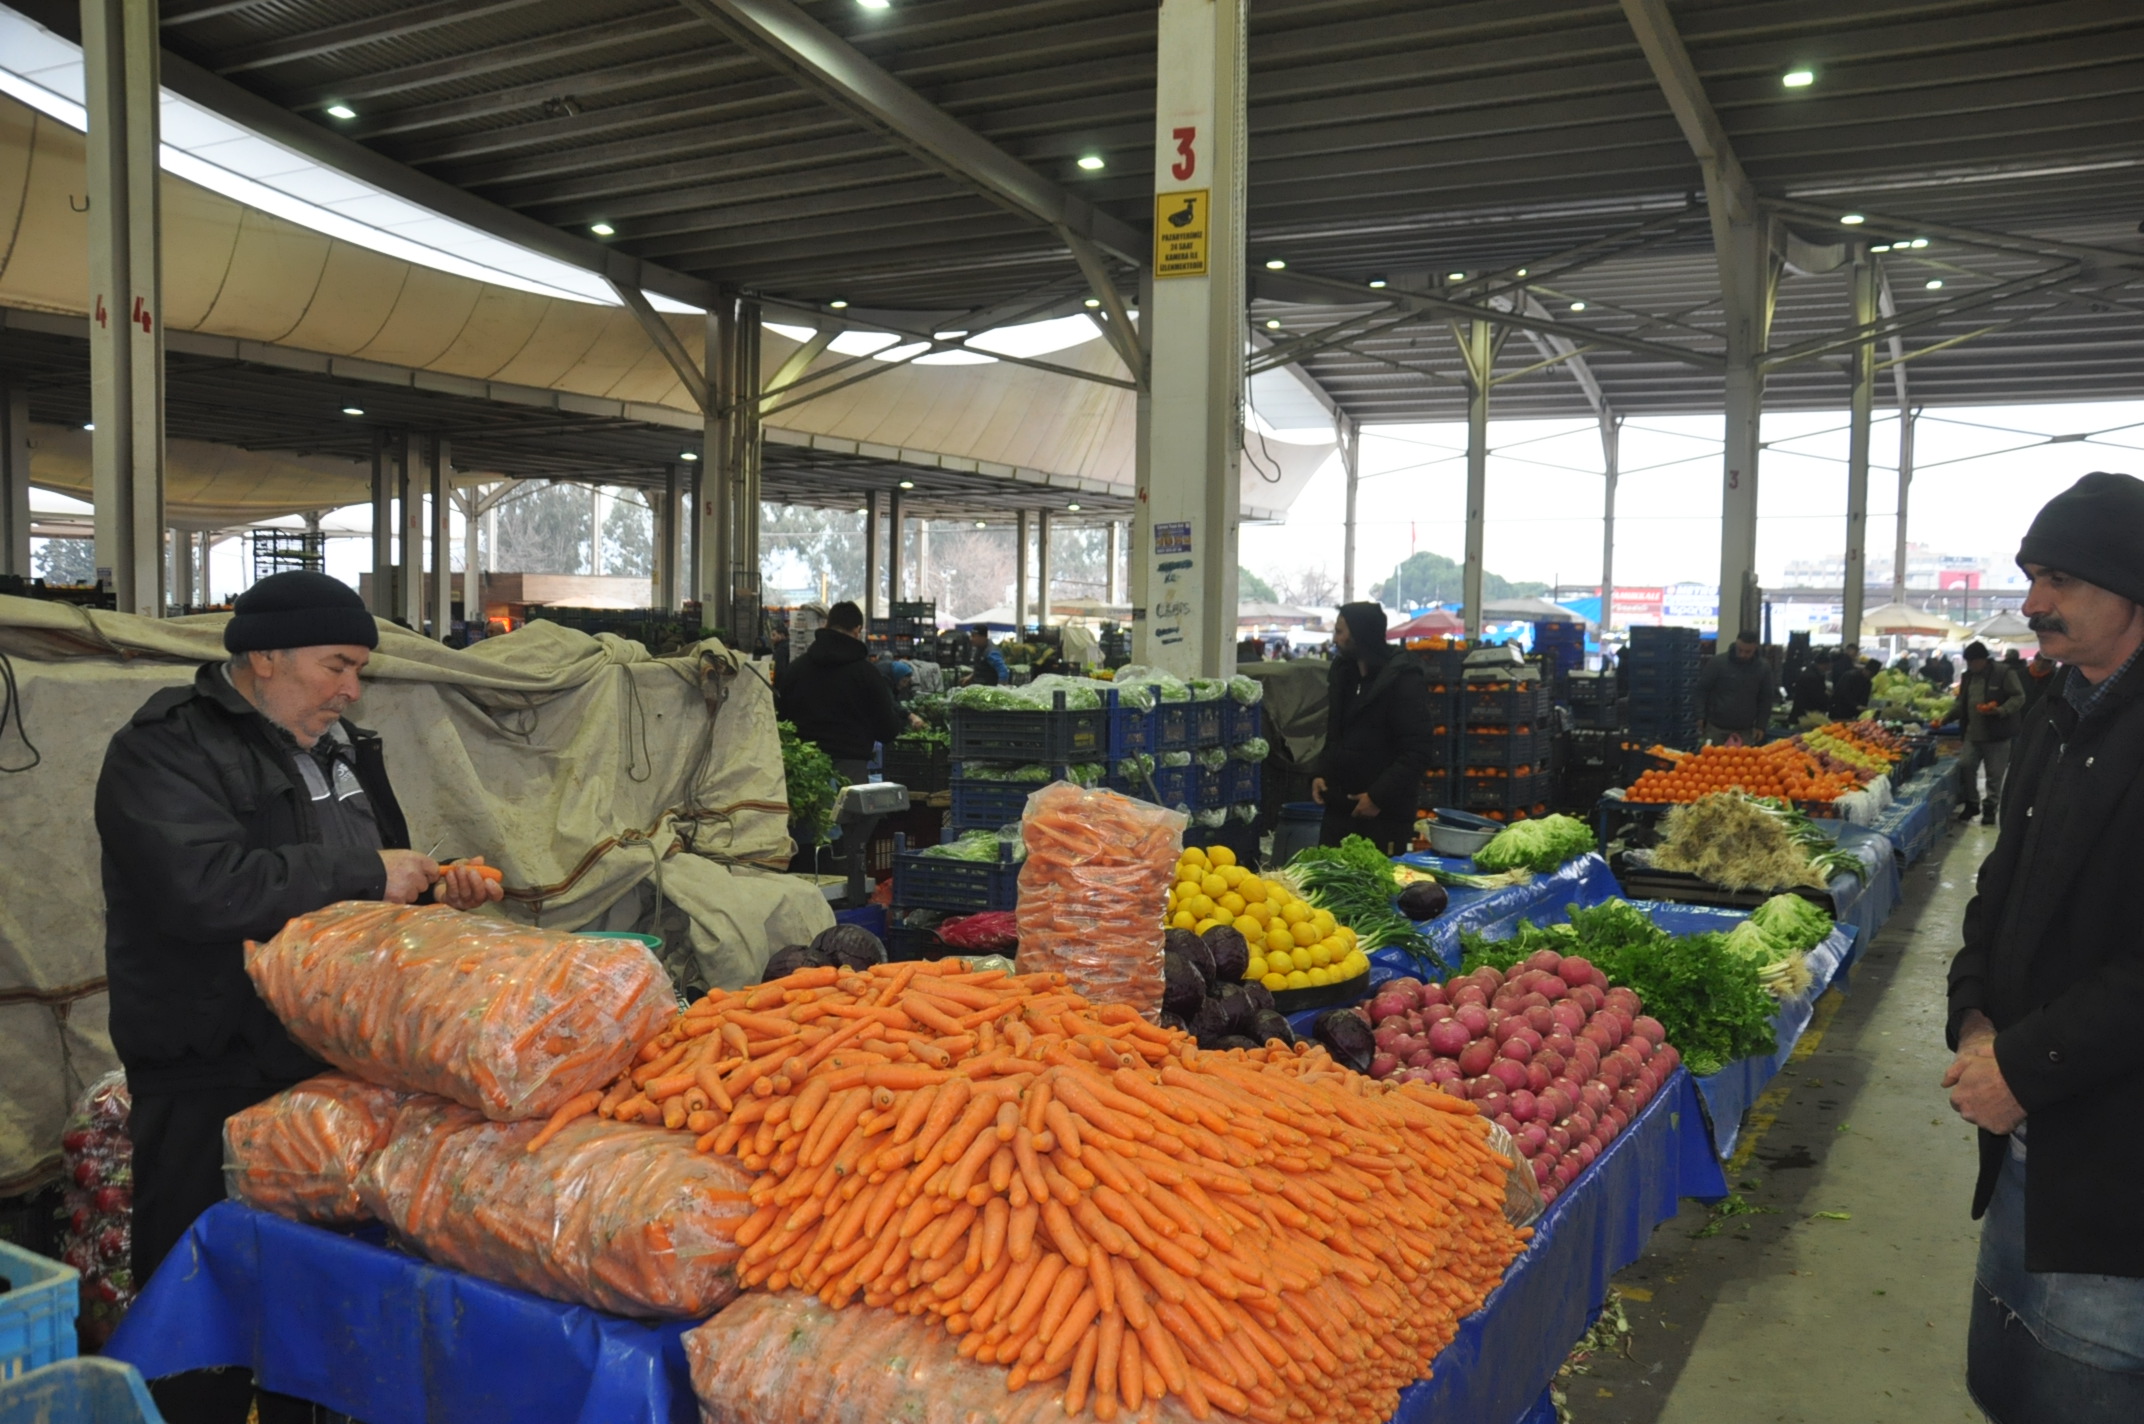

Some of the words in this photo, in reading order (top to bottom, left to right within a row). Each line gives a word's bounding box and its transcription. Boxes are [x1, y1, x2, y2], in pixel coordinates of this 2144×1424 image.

[1172, 126, 1196, 181] 3
[1170, 243, 1178, 251] 24
[1179, 242, 1193, 250] SAAT
[1165, 252, 1189, 261] KAMERA
[95, 294, 107, 328] 4
[133, 296, 151, 333] 4
[1729, 470, 1739, 489] 3
[1138, 486, 1147, 504] 4
[706, 501, 712, 516] 5
